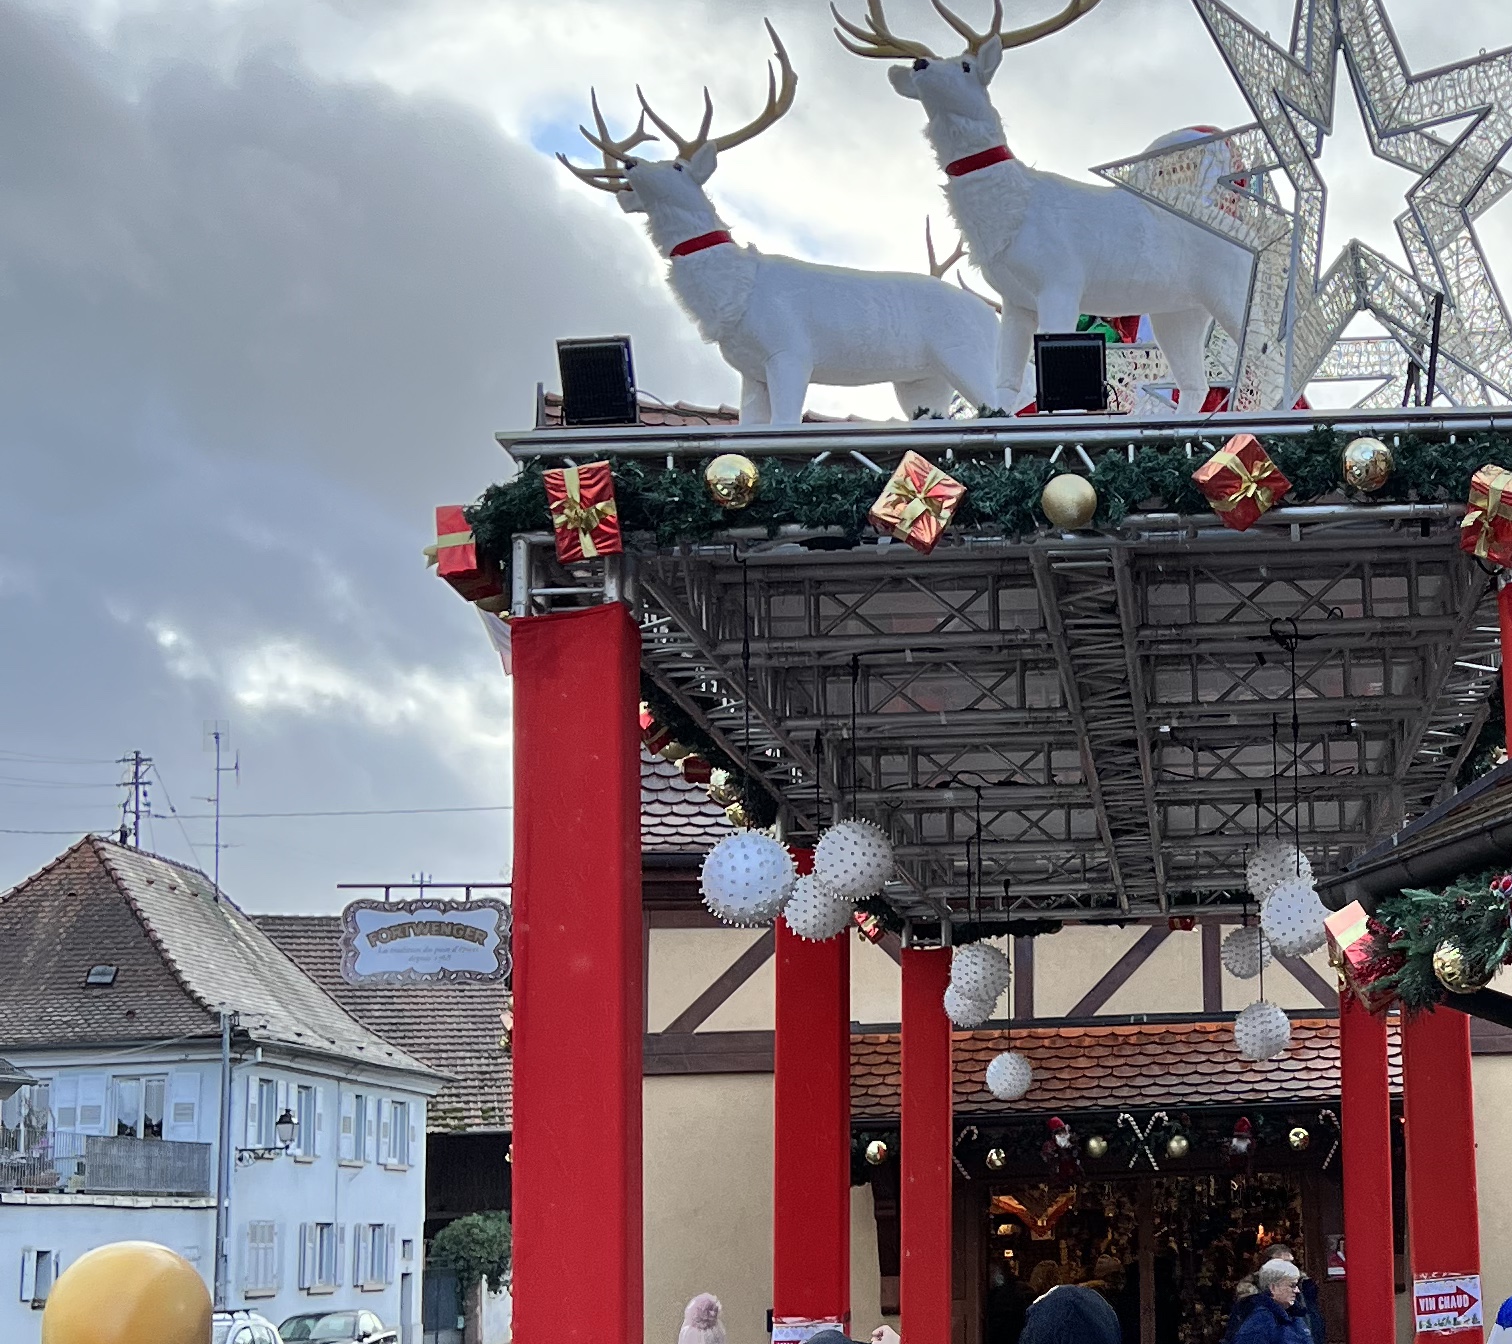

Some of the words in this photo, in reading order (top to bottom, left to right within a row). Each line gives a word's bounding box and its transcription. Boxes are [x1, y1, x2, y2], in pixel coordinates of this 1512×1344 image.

[366, 921, 488, 948] FORTWENGER
[1419, 1297, 1436, 1311] VIN
[1438, 1294, 1470, 1309] CHAUD
